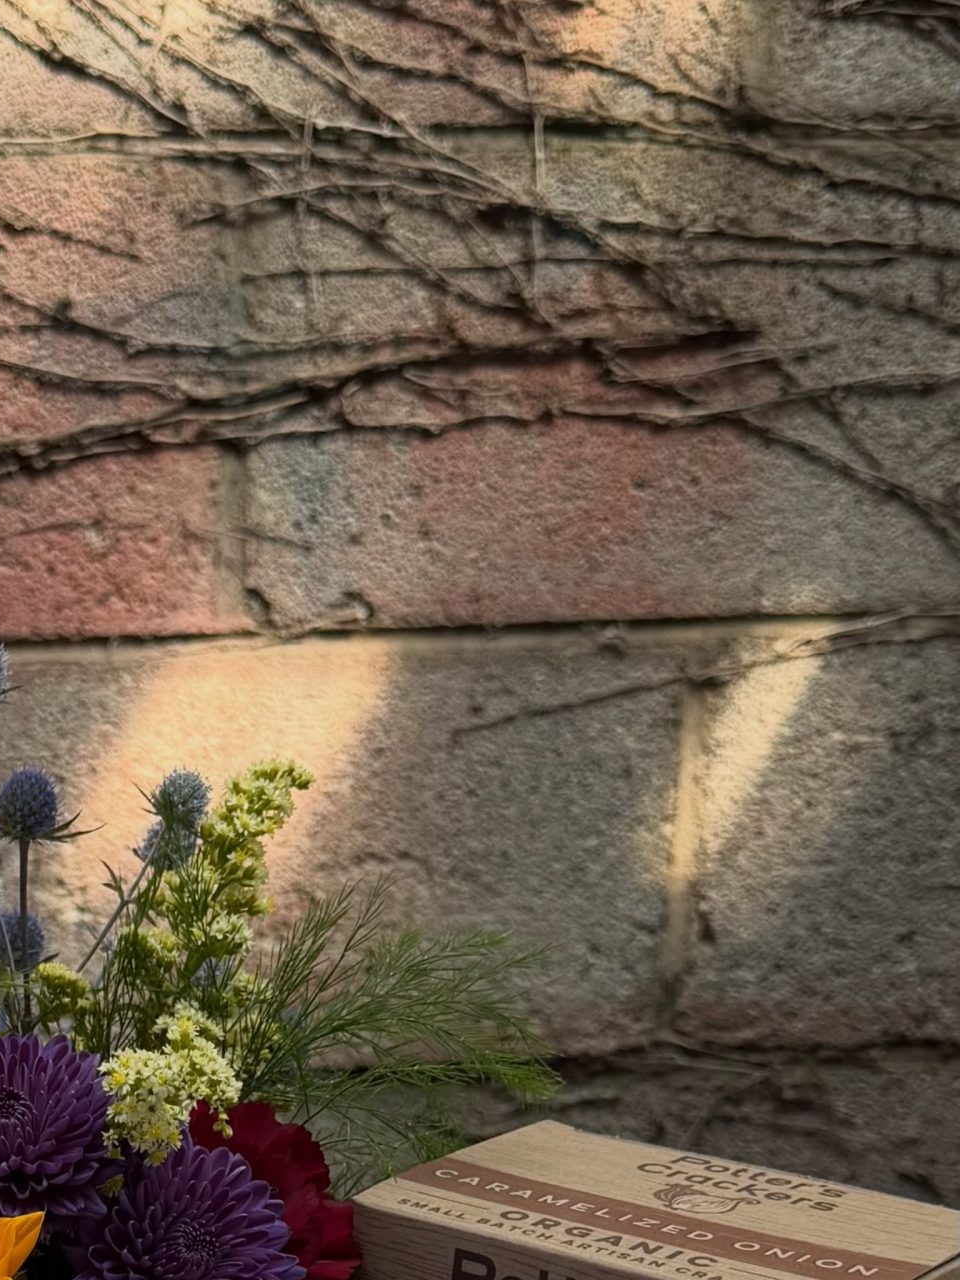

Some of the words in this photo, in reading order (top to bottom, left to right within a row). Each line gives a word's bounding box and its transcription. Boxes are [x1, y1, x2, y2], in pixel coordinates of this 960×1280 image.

[636, 1162, 835, 1213] Crackers
[669, 1154, 848, 1199] Potter's
[397, 1198, 466, 1221] SMALL
[477, 1216, 553, 1241] BATCH
[560, 1235, 665, 1271] ARTISAN
[433, 1168, 713, 1241] CARAMELIZED
[733, 1240, 880, 1278] ONION
[499, 1207, 720, 1270] ORGANIC
